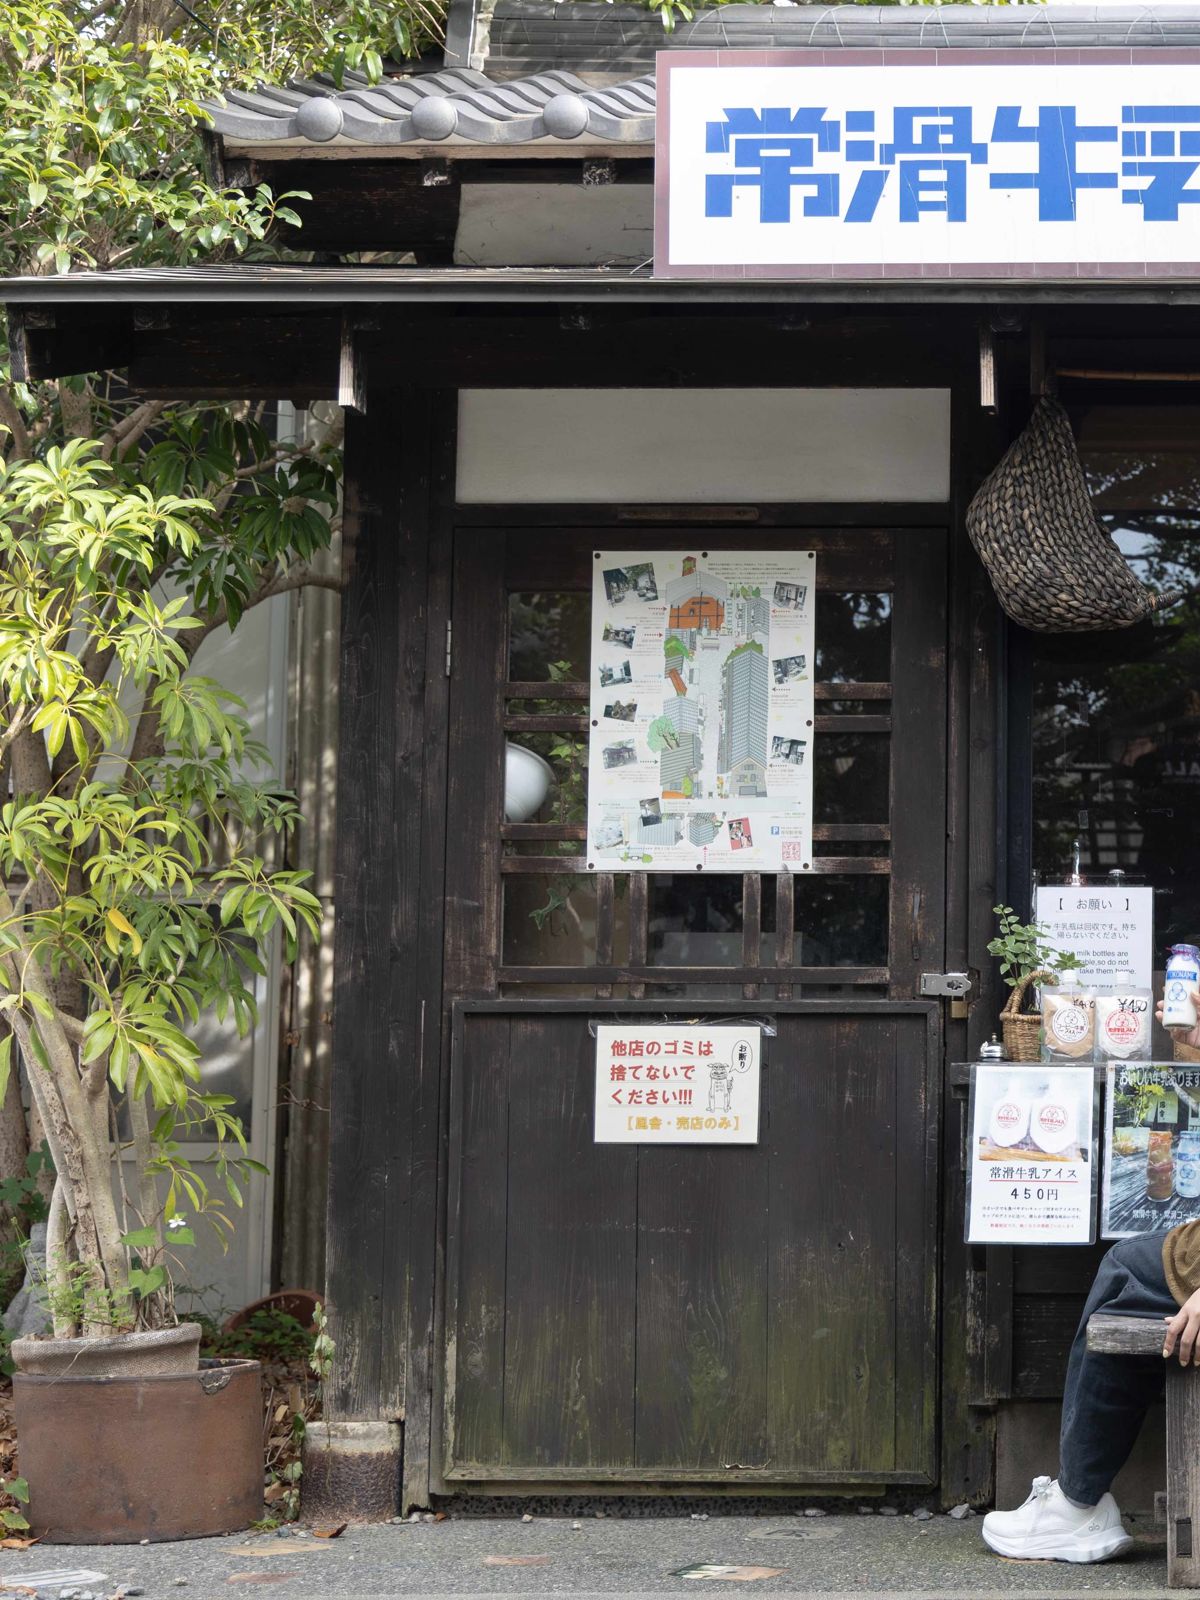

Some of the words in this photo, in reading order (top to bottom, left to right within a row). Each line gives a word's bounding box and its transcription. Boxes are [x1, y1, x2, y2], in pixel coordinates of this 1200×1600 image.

[610, 1039, 714, 1057] 他店のゴミは
[738, 1044, 747, 1069] お断り
[610, 1064, 696, 1081] 捨てないで
[611, 1089, 693, 1105] ください!!!
[990, 1166, 1077, 1180] 常滑牛乳アイス
